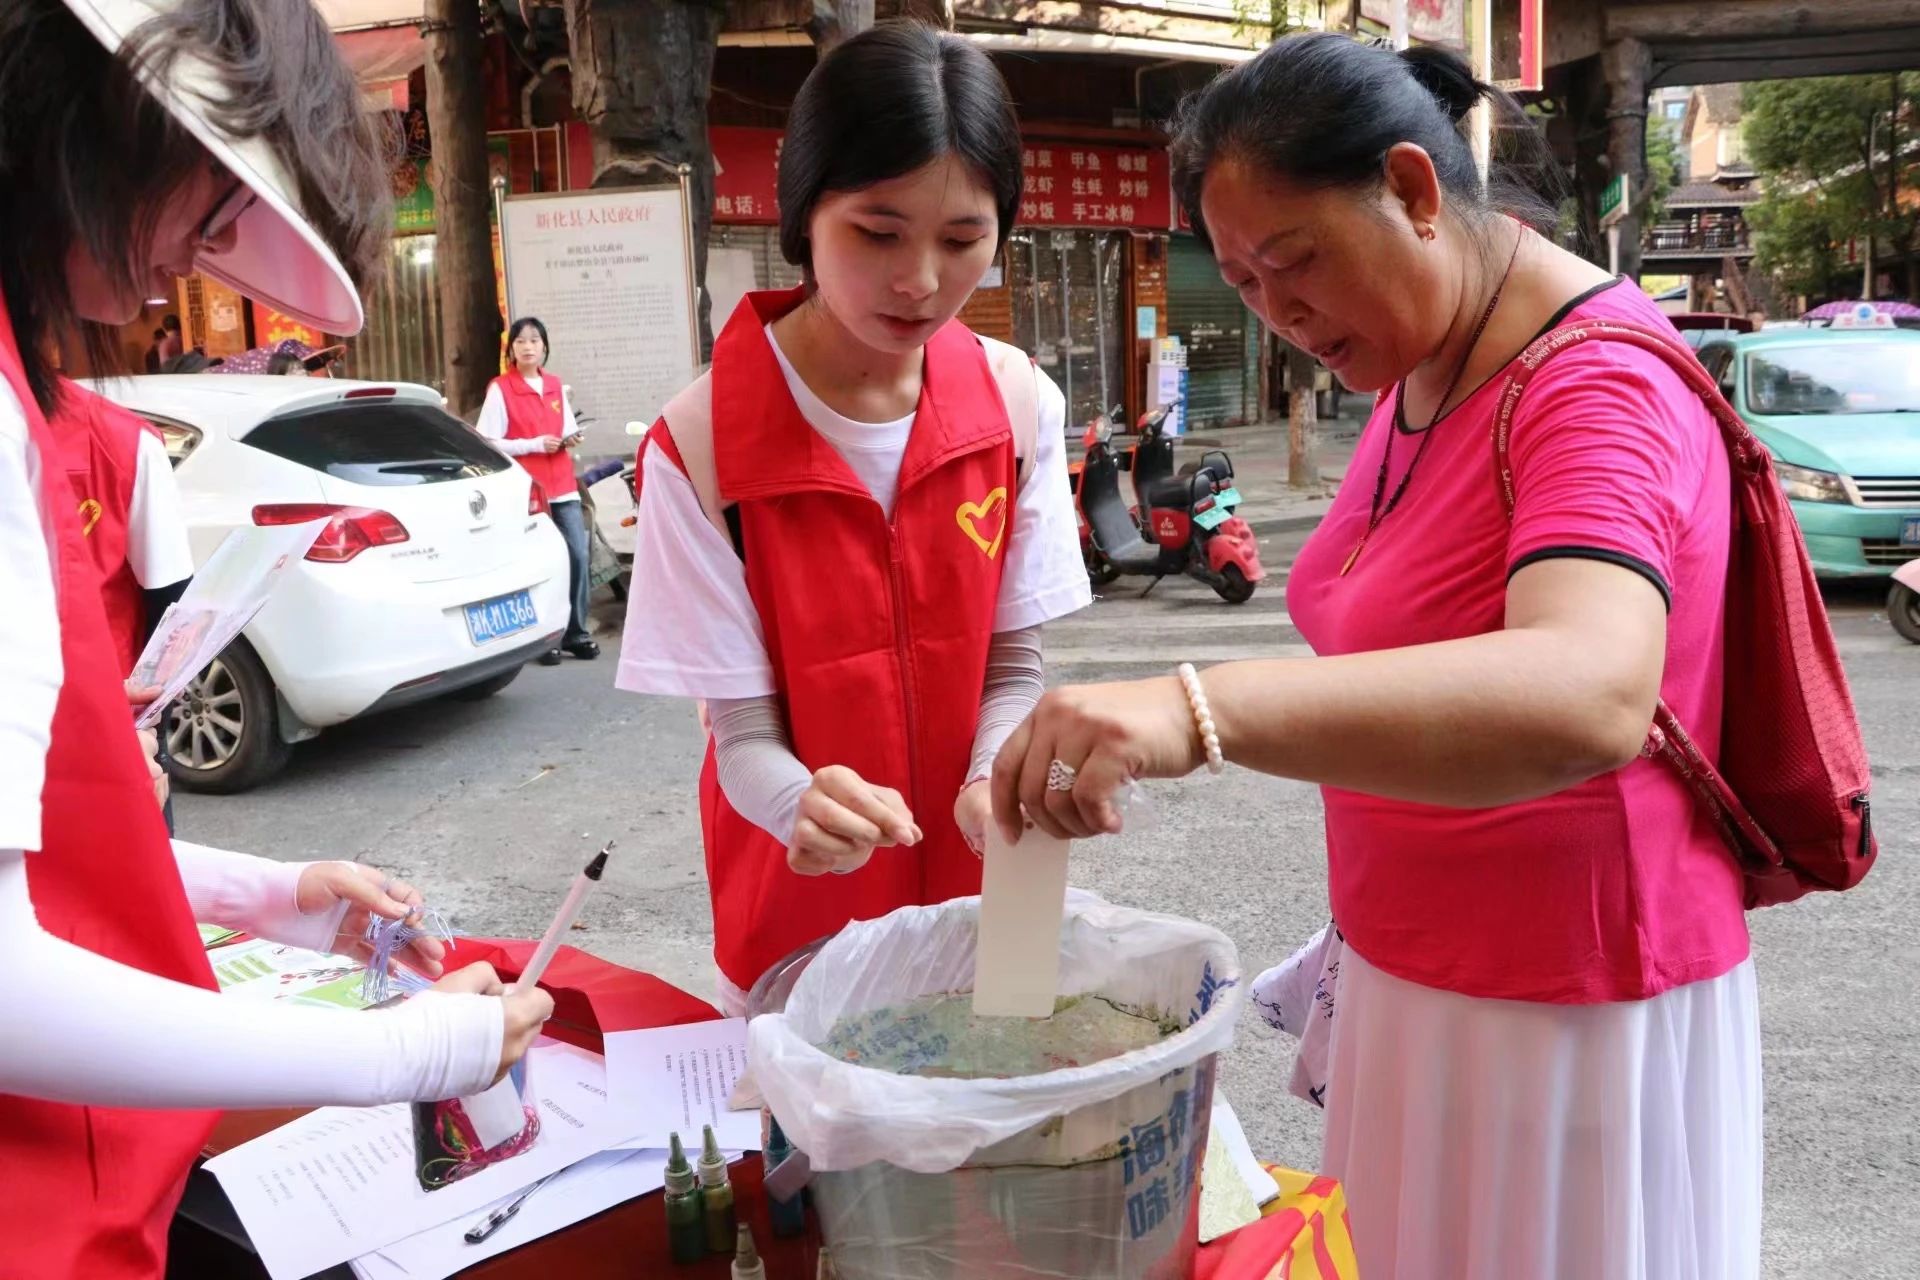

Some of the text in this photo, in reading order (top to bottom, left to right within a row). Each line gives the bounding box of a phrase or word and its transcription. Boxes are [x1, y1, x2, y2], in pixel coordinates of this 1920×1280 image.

[1071, 152, 1101, 170] 甲鱼
[1071, 177, 1103, 196] 生蚝
[1119, 179, 1149, 198] 炒粉
[535, 205, 650, 230] 新化县人民政府
[1022, 200, 1134, 222] 炒饭 手工冰粉
[1501, 395, 1515, 420] UNDER
[1498, 421, 1508, 453] ARMOUR
